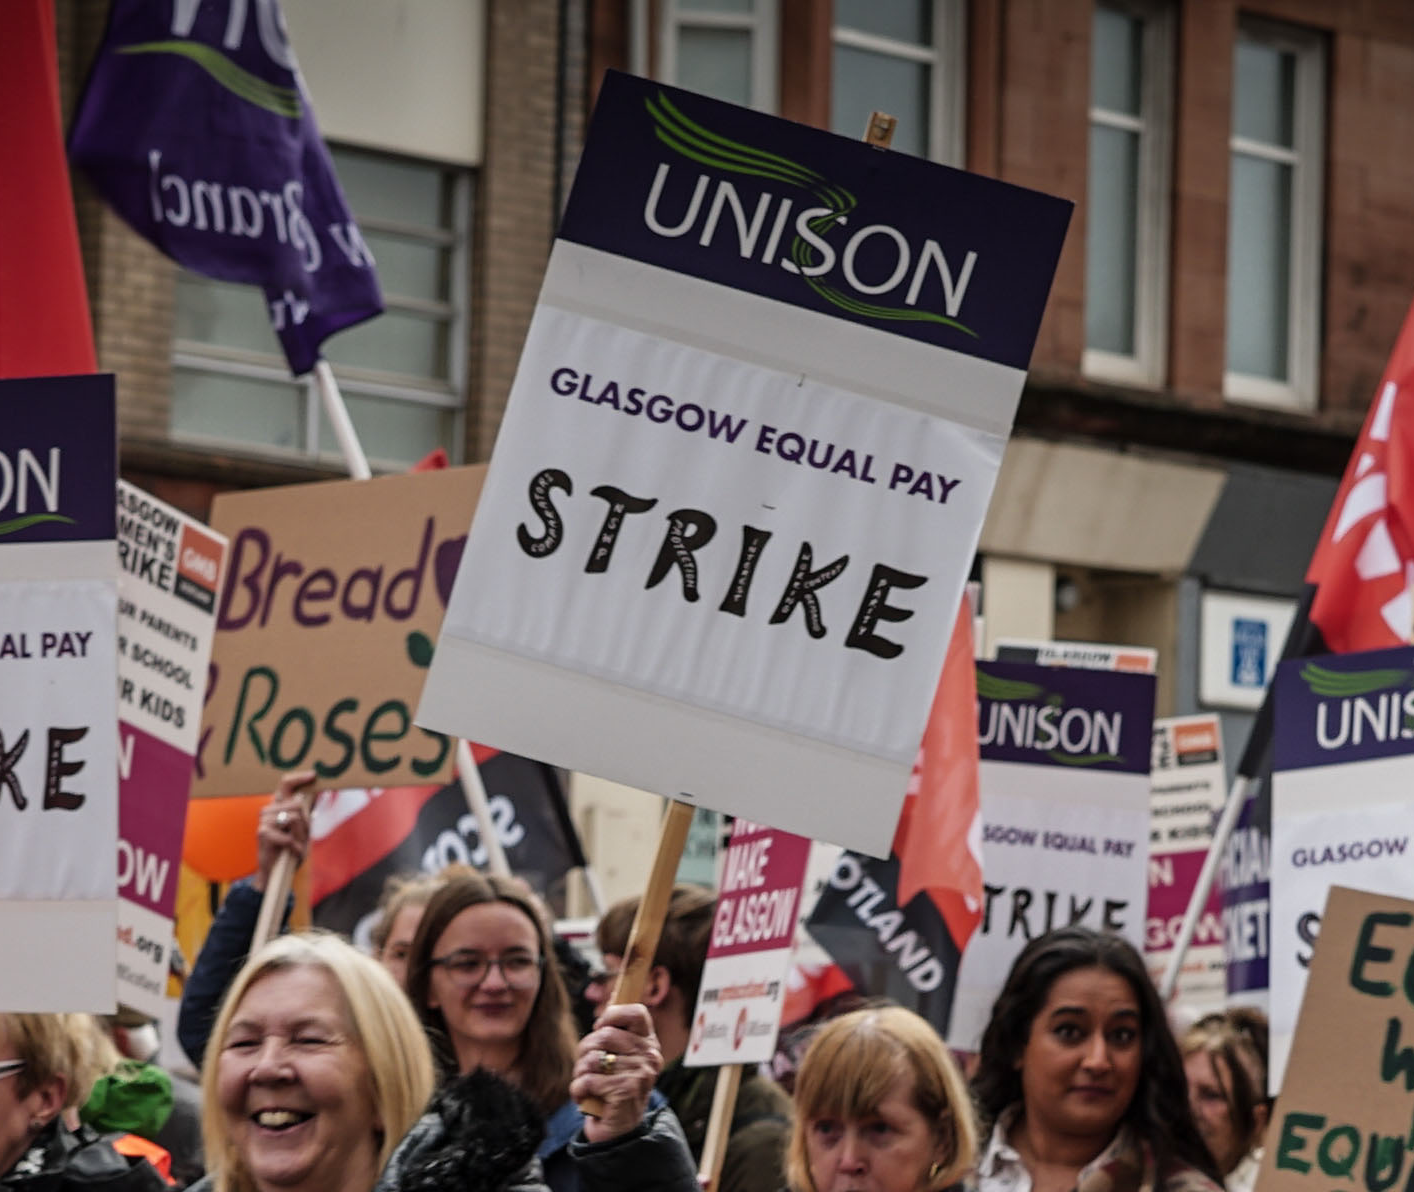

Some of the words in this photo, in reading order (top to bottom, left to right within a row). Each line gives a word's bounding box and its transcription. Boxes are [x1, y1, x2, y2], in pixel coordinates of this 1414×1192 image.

[640, 161, 978, 319] UNISON
[549, 366, 748, 446] GLASGOW
[754, 425, 878, 486] EQUAL
[887, 463, 961, 506] PAY
[118, 541, 172, 592] RIKE
[120, 515, 176, 562] MEN'S
[516, 468, 929, 660] STRIKE
[217, 516, 435, 635] Bread
[41, 631, 93, 657] PAY
[140, 607, 199, 652] PARENTS
[132, 643, 194, 690] SCHOOL
[141, 687, 186, 730] KIDS
[224, 666, 450, 777] Roses
[977, 700, 1123, 757] UNISON
[721, 836, 774, 895] MAKE
[983, 826, 1038, 848] SGOW
[1043, 829, 1098, 855] EQUAL
[1103, 841, 1135, 858] PAY
[1292, 834, 1409, 868] GLASGOW
[713, 886, 799, 948] GLASGOW
[828, 855, 945, 992] OTLAND
[982, 883, 1129, 940] TRIKE
